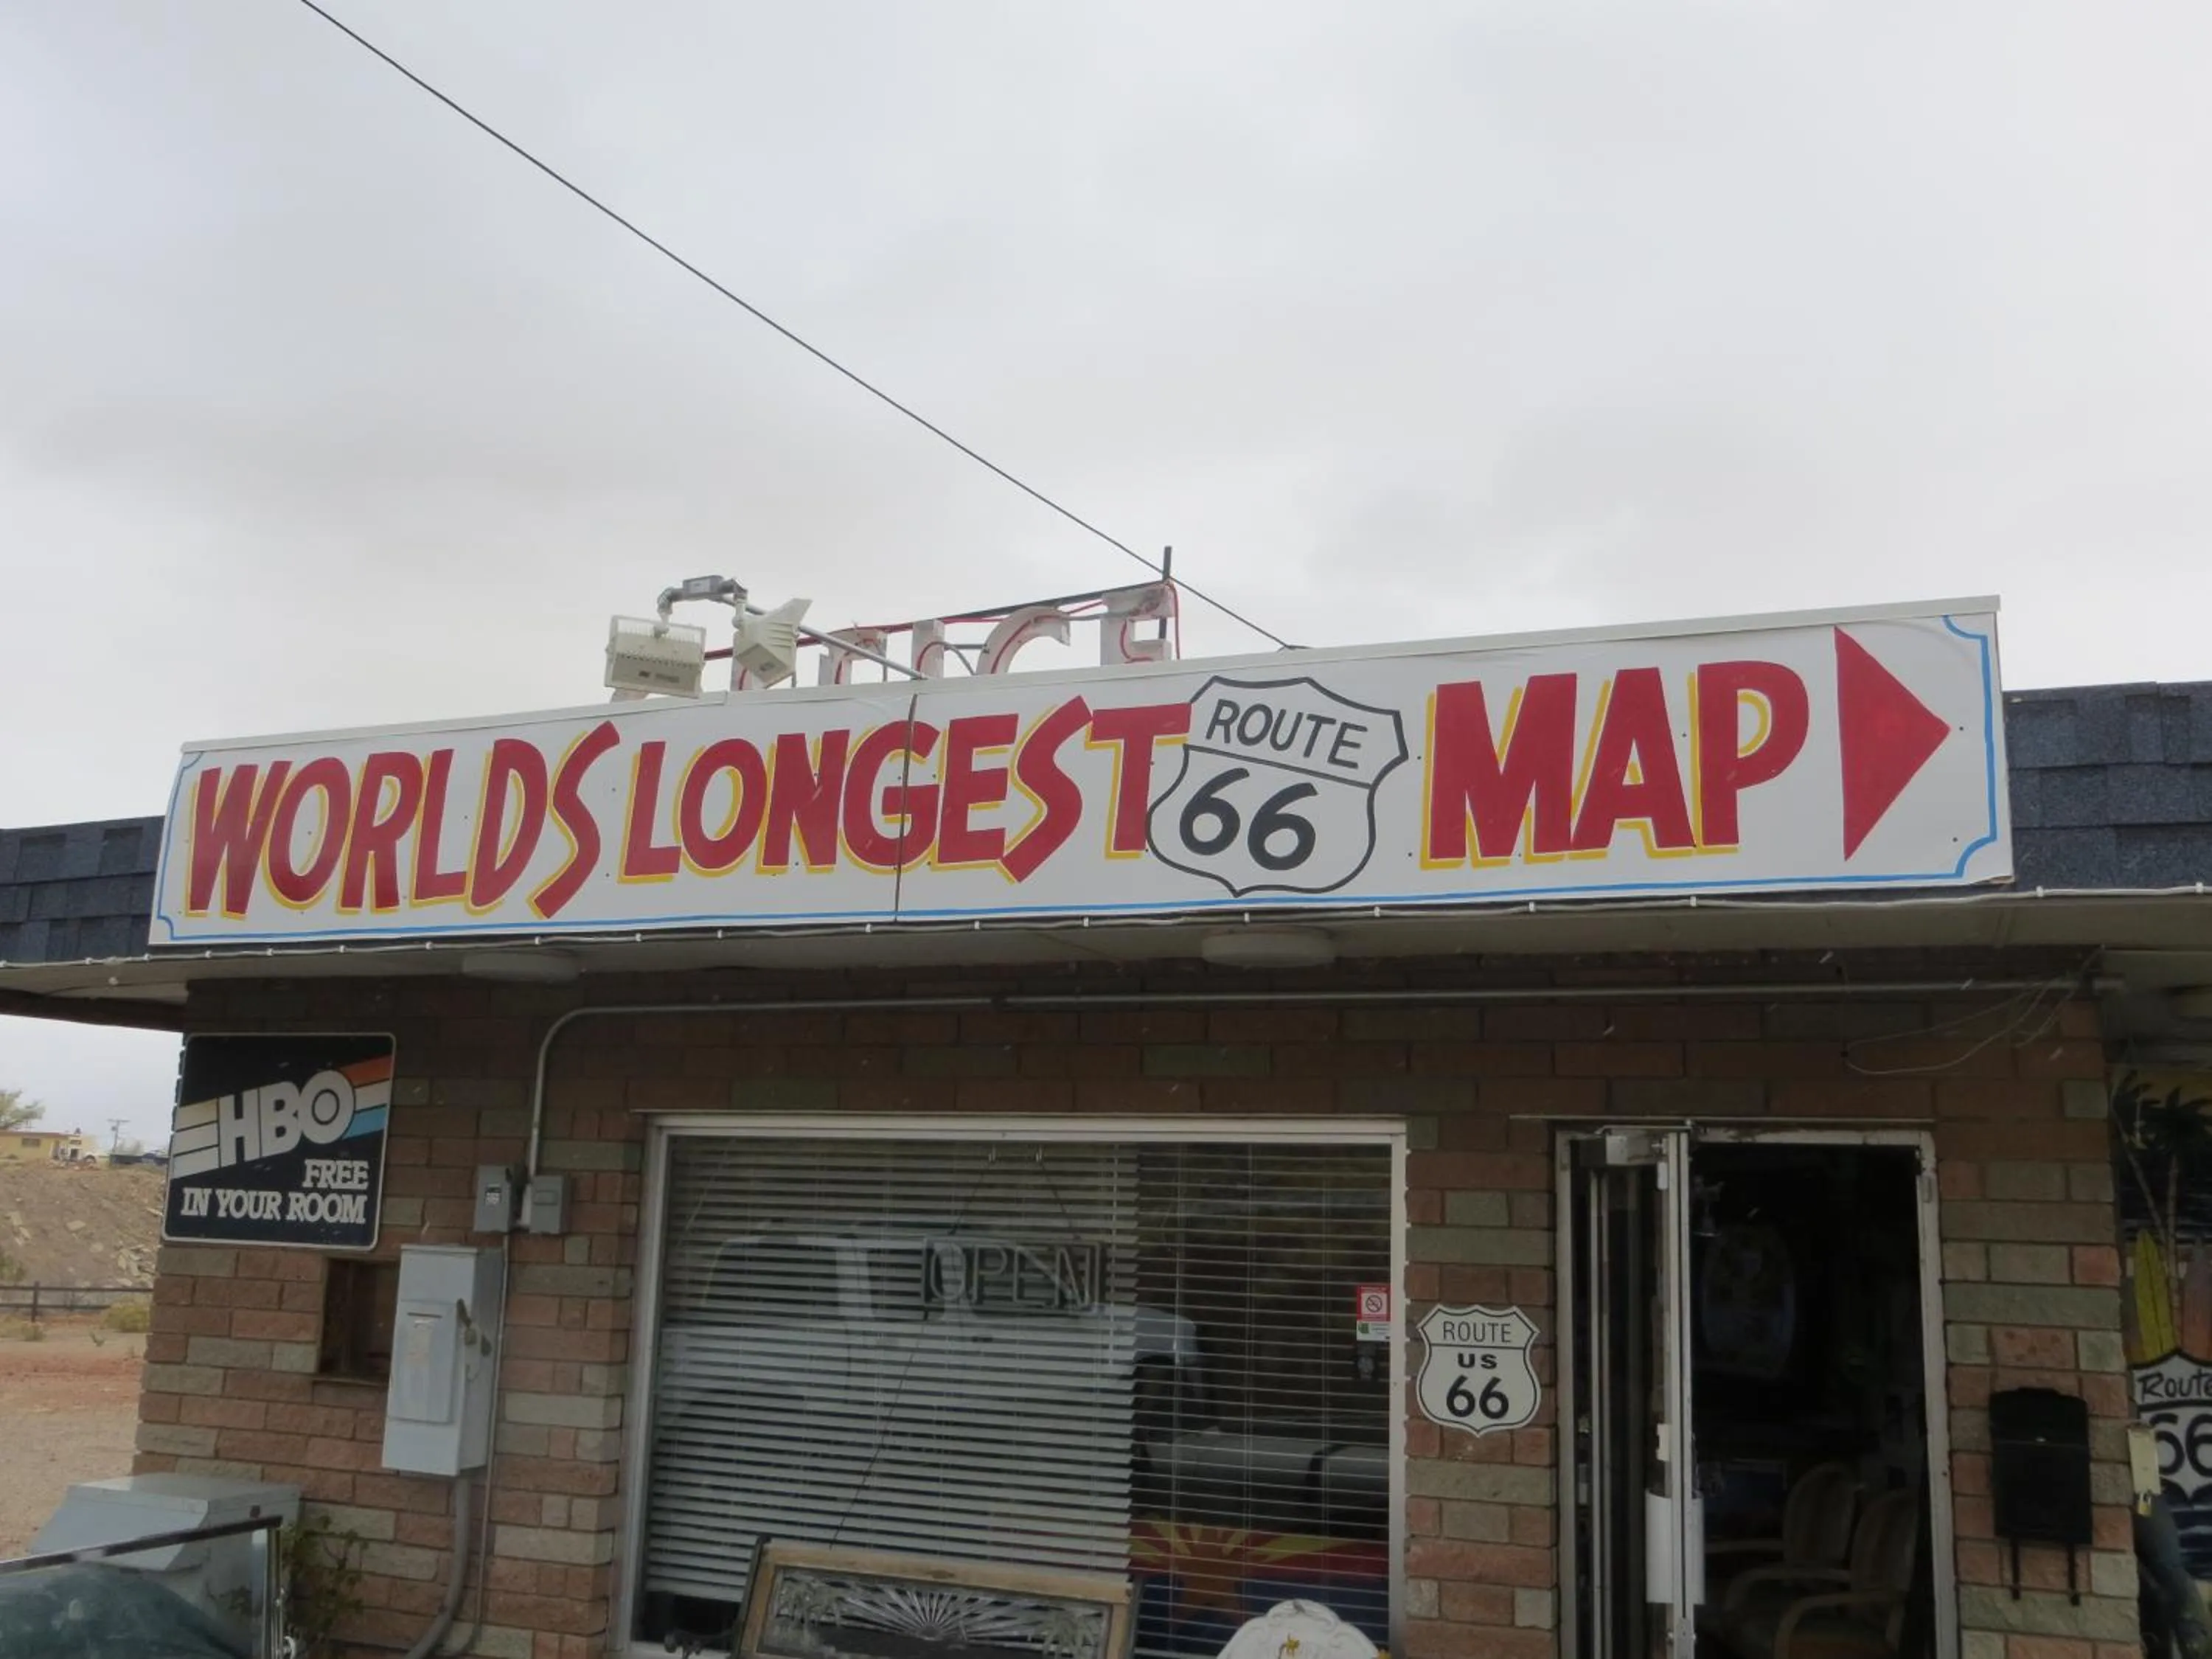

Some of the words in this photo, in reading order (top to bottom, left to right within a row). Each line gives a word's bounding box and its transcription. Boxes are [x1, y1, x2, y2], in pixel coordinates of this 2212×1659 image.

[1205, 697, 1368, 771] ROUTE
[1419, 659, 1810, 870] MAP
[184, 720, 620, 919] WORLDS
[617, 695, 1193, 884] LONGEST
[1179, 767, 1319, 872] 66
[219, 1069, 355, 1168] HBO
[181, 1187, 212, 1217] IN
[215, 1189, 282, 1221] YOUR
[285, 1192, 368, 1225] ROOM
[302, 1158, 369, 1190] FREE
[931, 1242, 1091, 1310] OPEN
[1442, 1320, 1512, 1343] ROUTE
[1457, 1352, 1498, 1370] US
[1446, 1374, 1510, 1420] 66
